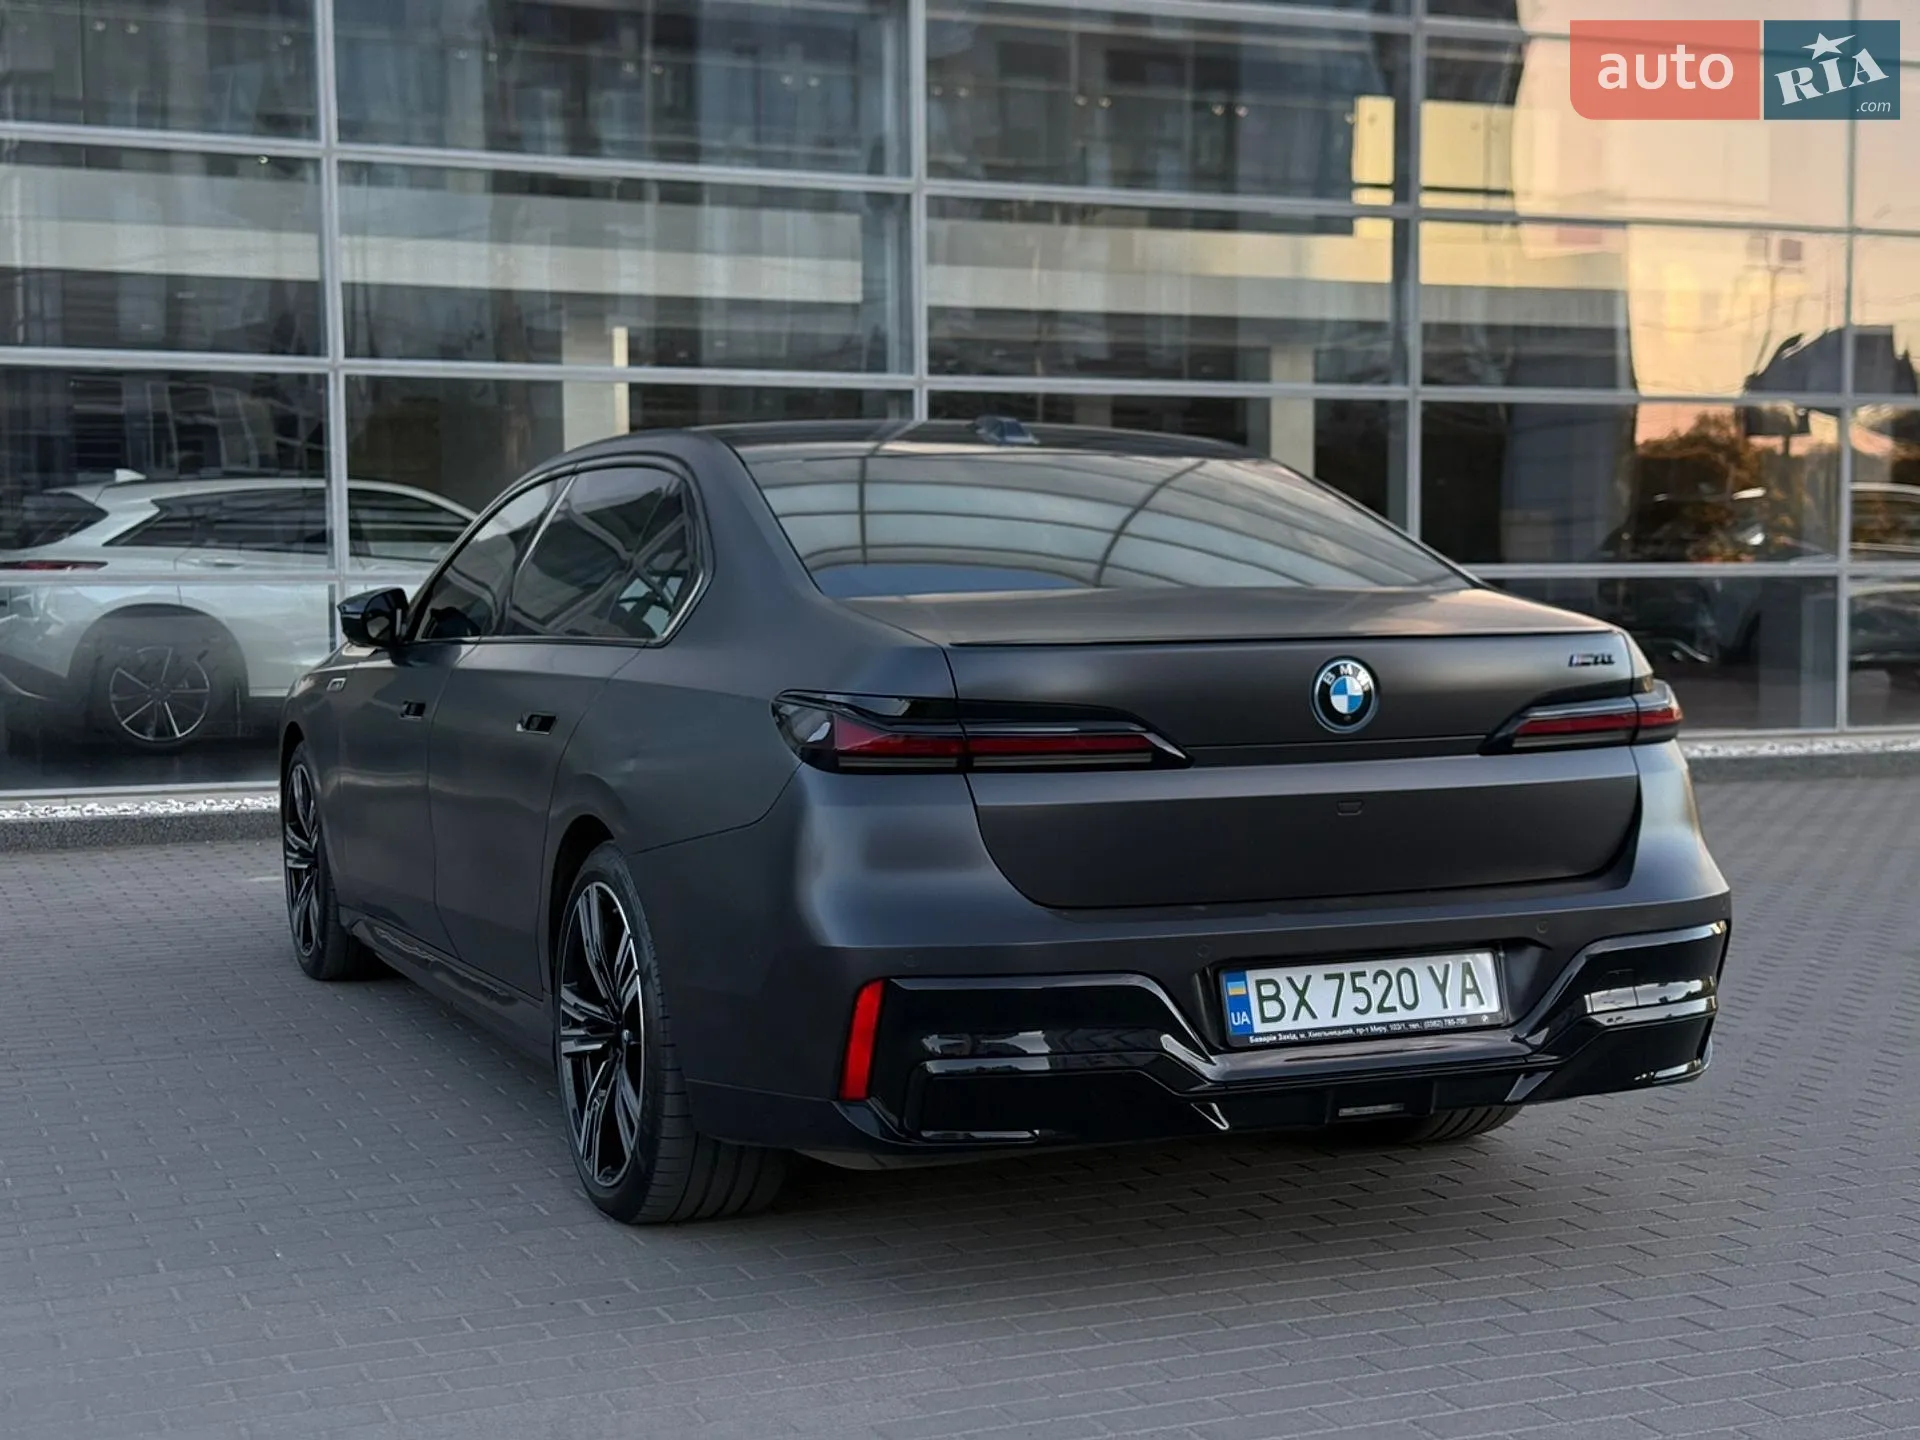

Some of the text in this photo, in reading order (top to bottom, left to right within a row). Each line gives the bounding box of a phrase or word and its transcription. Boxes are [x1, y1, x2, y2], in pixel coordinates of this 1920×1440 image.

[1323, 966, 1420, 1019] 7520
[1427, 960, 1486, 1010] YA
[1230, 1011, 1251, 1026] UA
